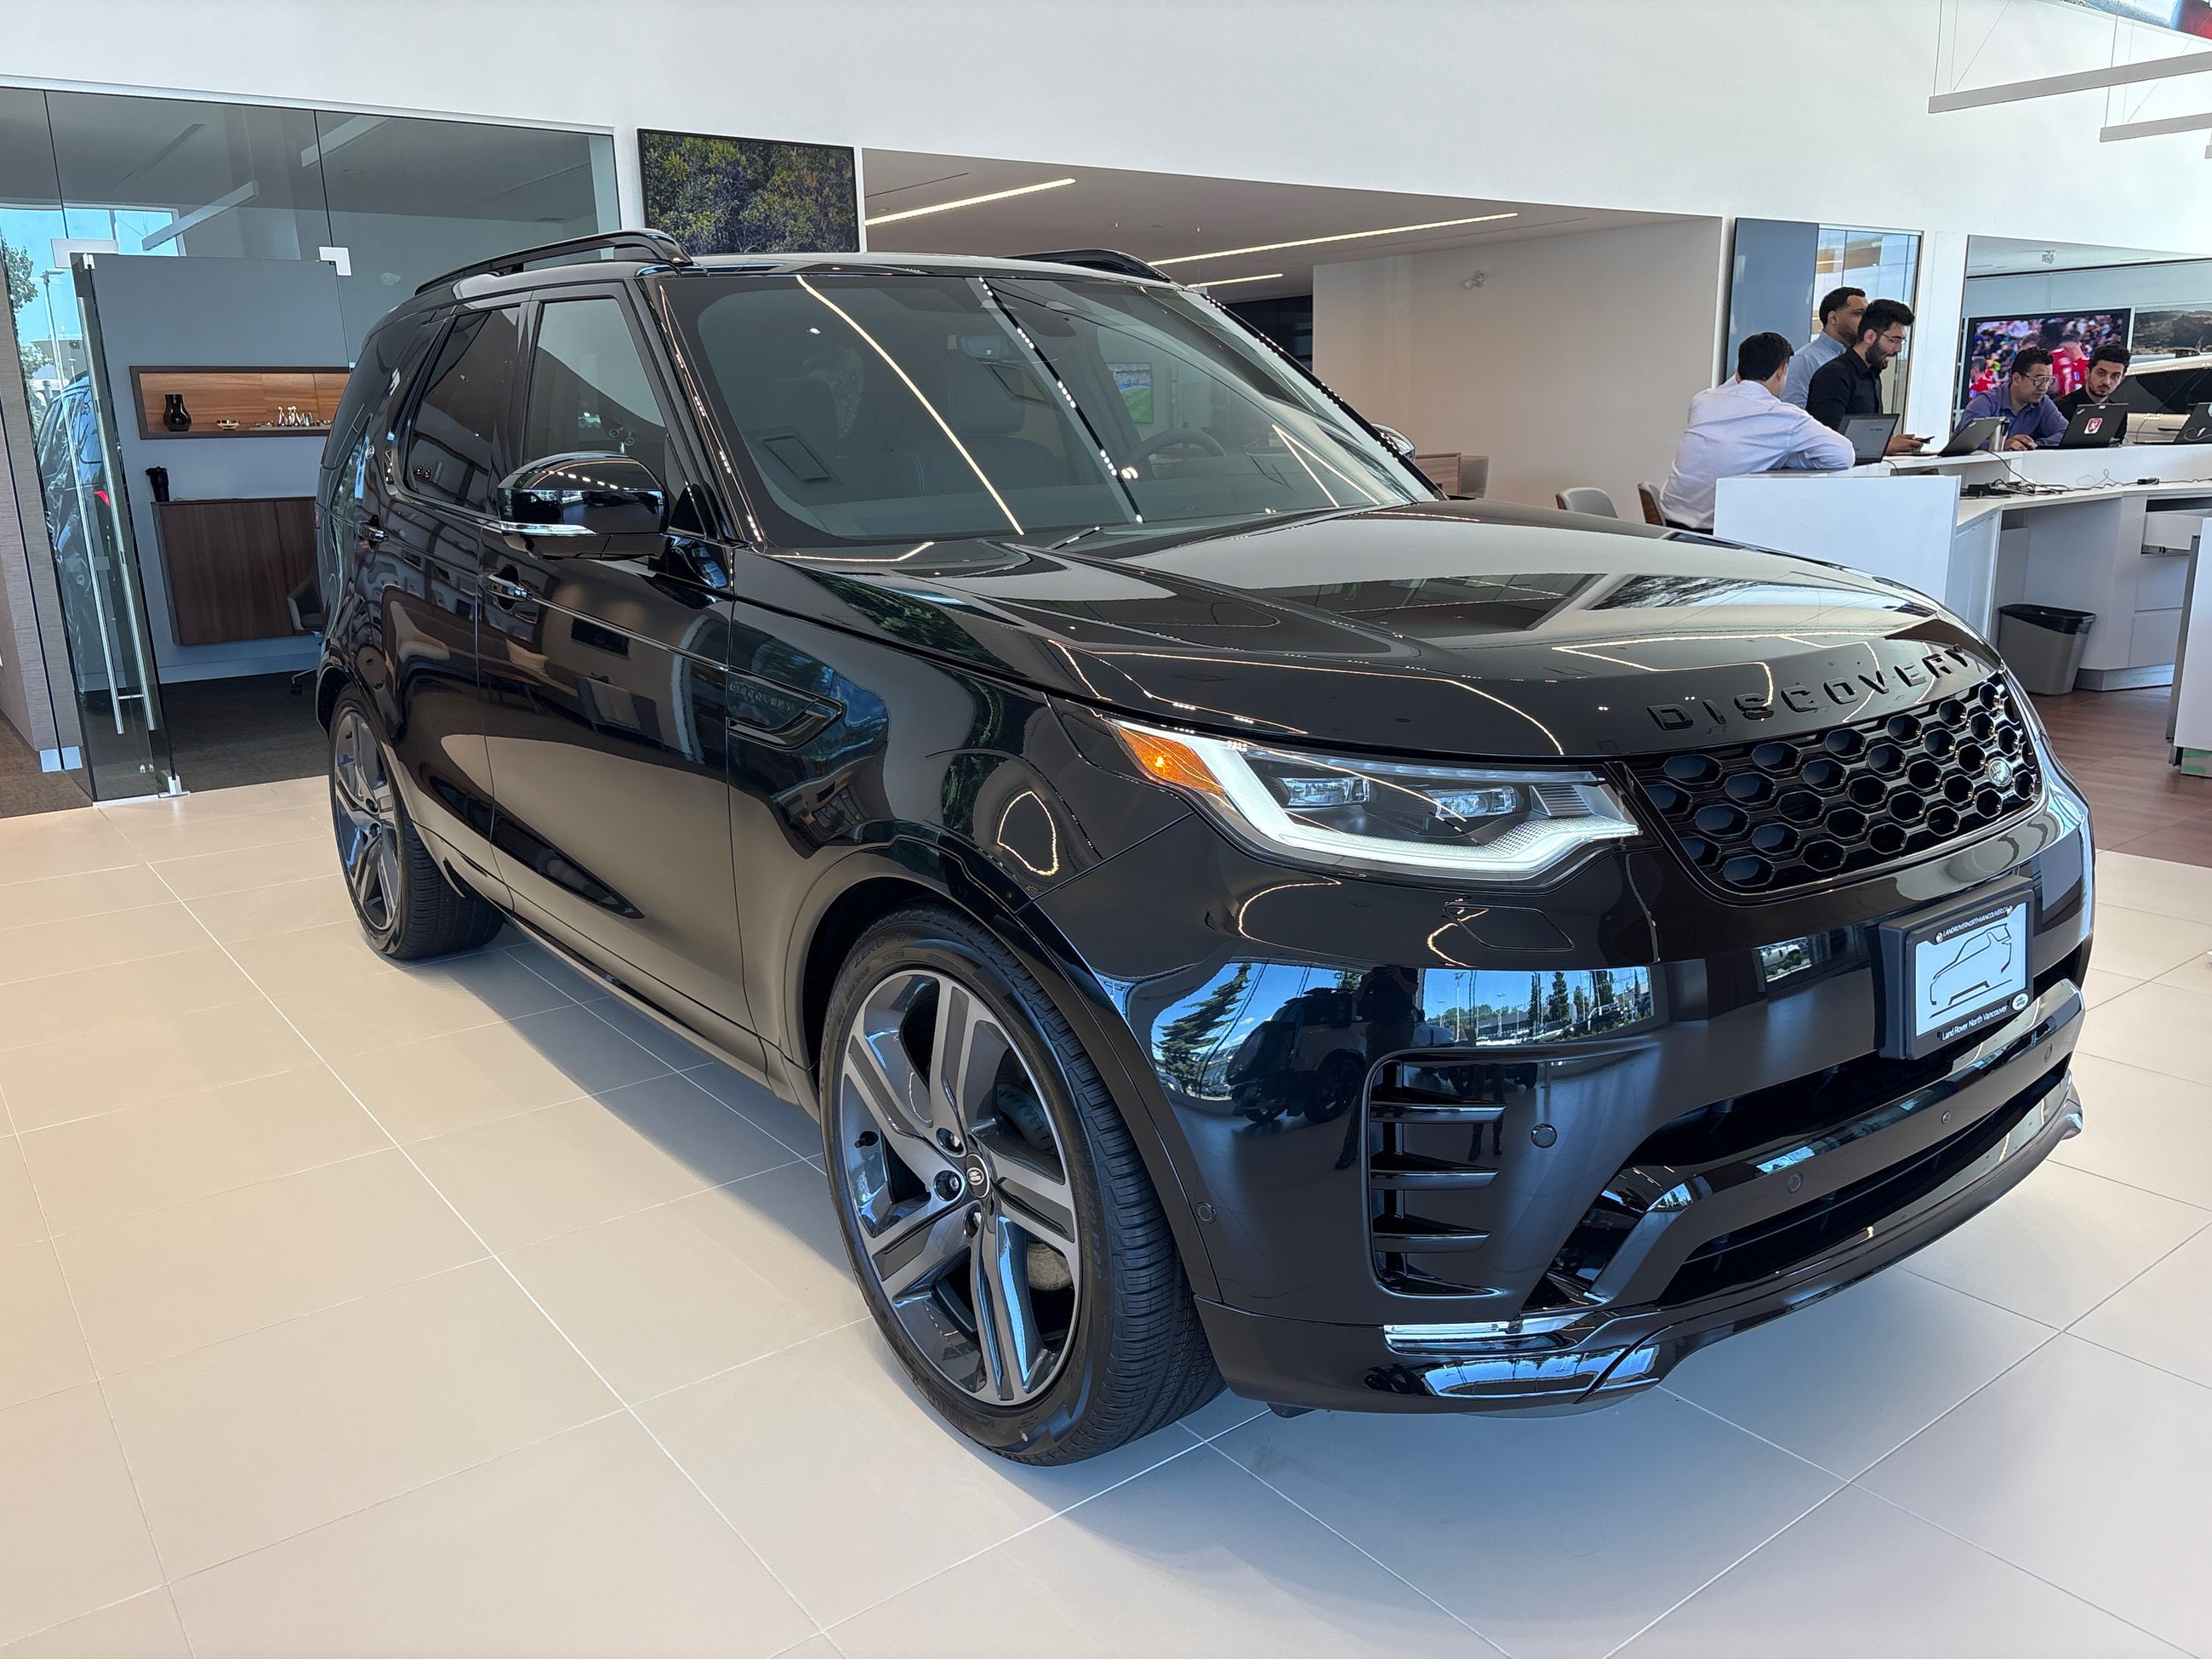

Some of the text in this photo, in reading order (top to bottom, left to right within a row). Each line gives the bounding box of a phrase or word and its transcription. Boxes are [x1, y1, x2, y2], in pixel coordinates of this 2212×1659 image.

[1647, 645, 1968, 731] DISCOVERY
[1941, 1005, 2008, 1040] Land Rover North Vancouver
